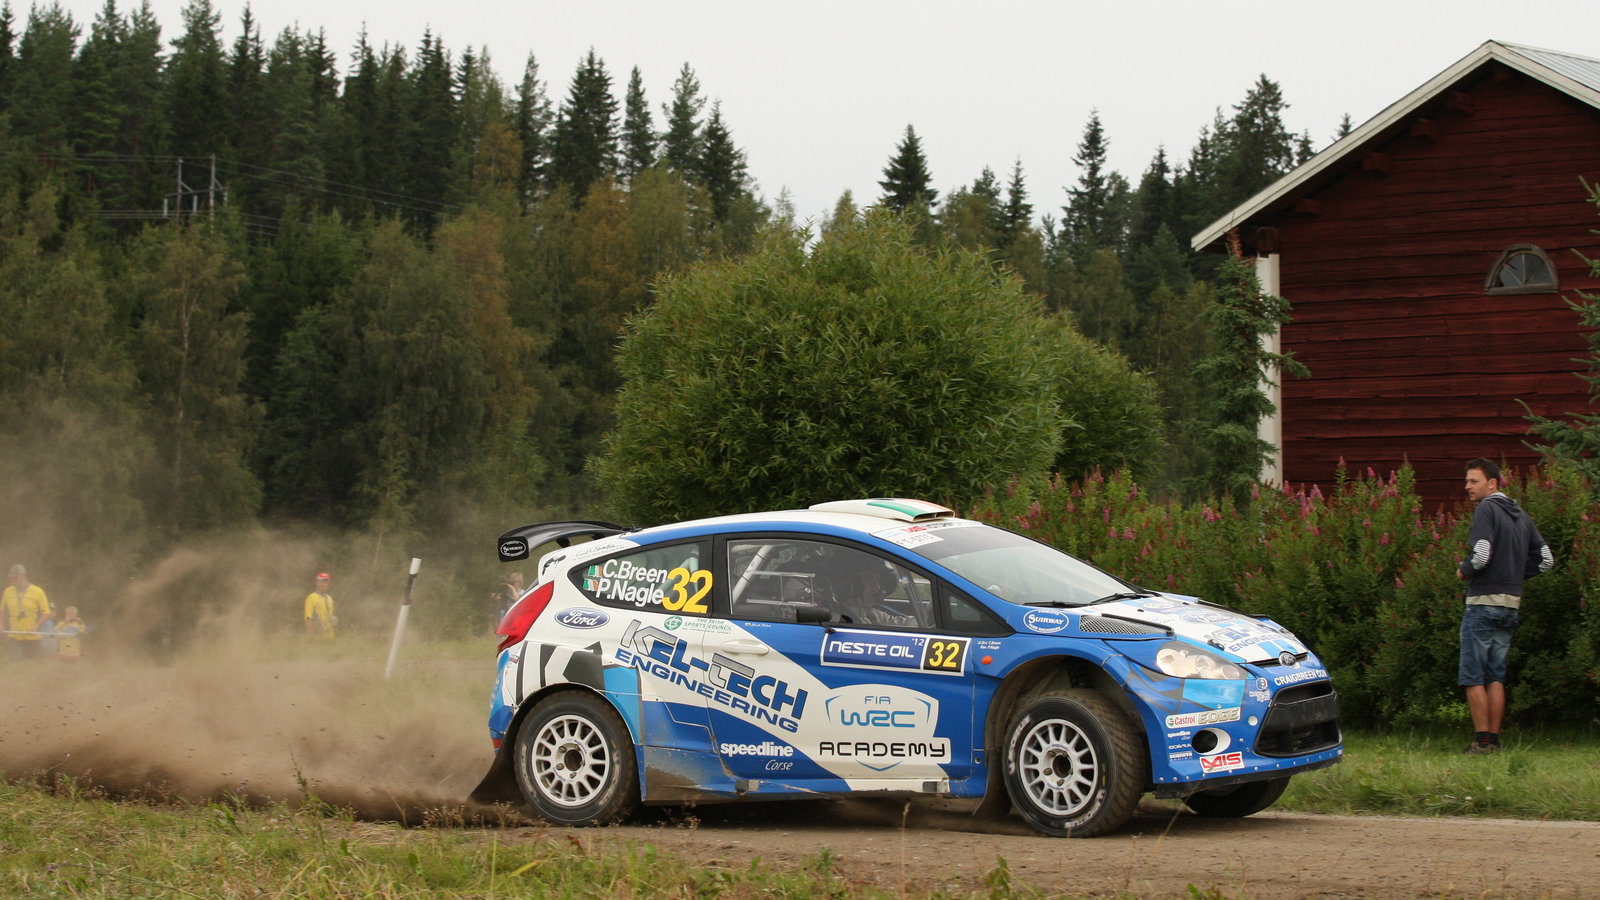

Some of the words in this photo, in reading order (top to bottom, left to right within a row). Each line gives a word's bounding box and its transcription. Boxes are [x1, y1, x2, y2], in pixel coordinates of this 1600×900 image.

[603, 559, 668, 584] C.Breen
[596, 579, 664, 607] P.Nagle
[662, 567, 713, 614] 32
[563, 610, 600, 626] Ford
[1028, 614, 1064, 624] SUIRWAY
[829, 640, 886, 656] NESTE
[890, 646, 914, 658] OIL
[928, 642, 960, 668] 32
[620, 619, 808, 720] KEL-TECH
[615, 648, 798, 733] ENGINEERING
[864, 696, 891, 704] FIA
[841, 709, 916, 728] WRC
[1174, 716, 1196, 726] Castrol
[1199, 708, 1239, 724] EDGE
[720, 742, 794, 757] speedline
[820, 742, 946, 758] ACADEMY
[764, 759, 794, 771] Corse
